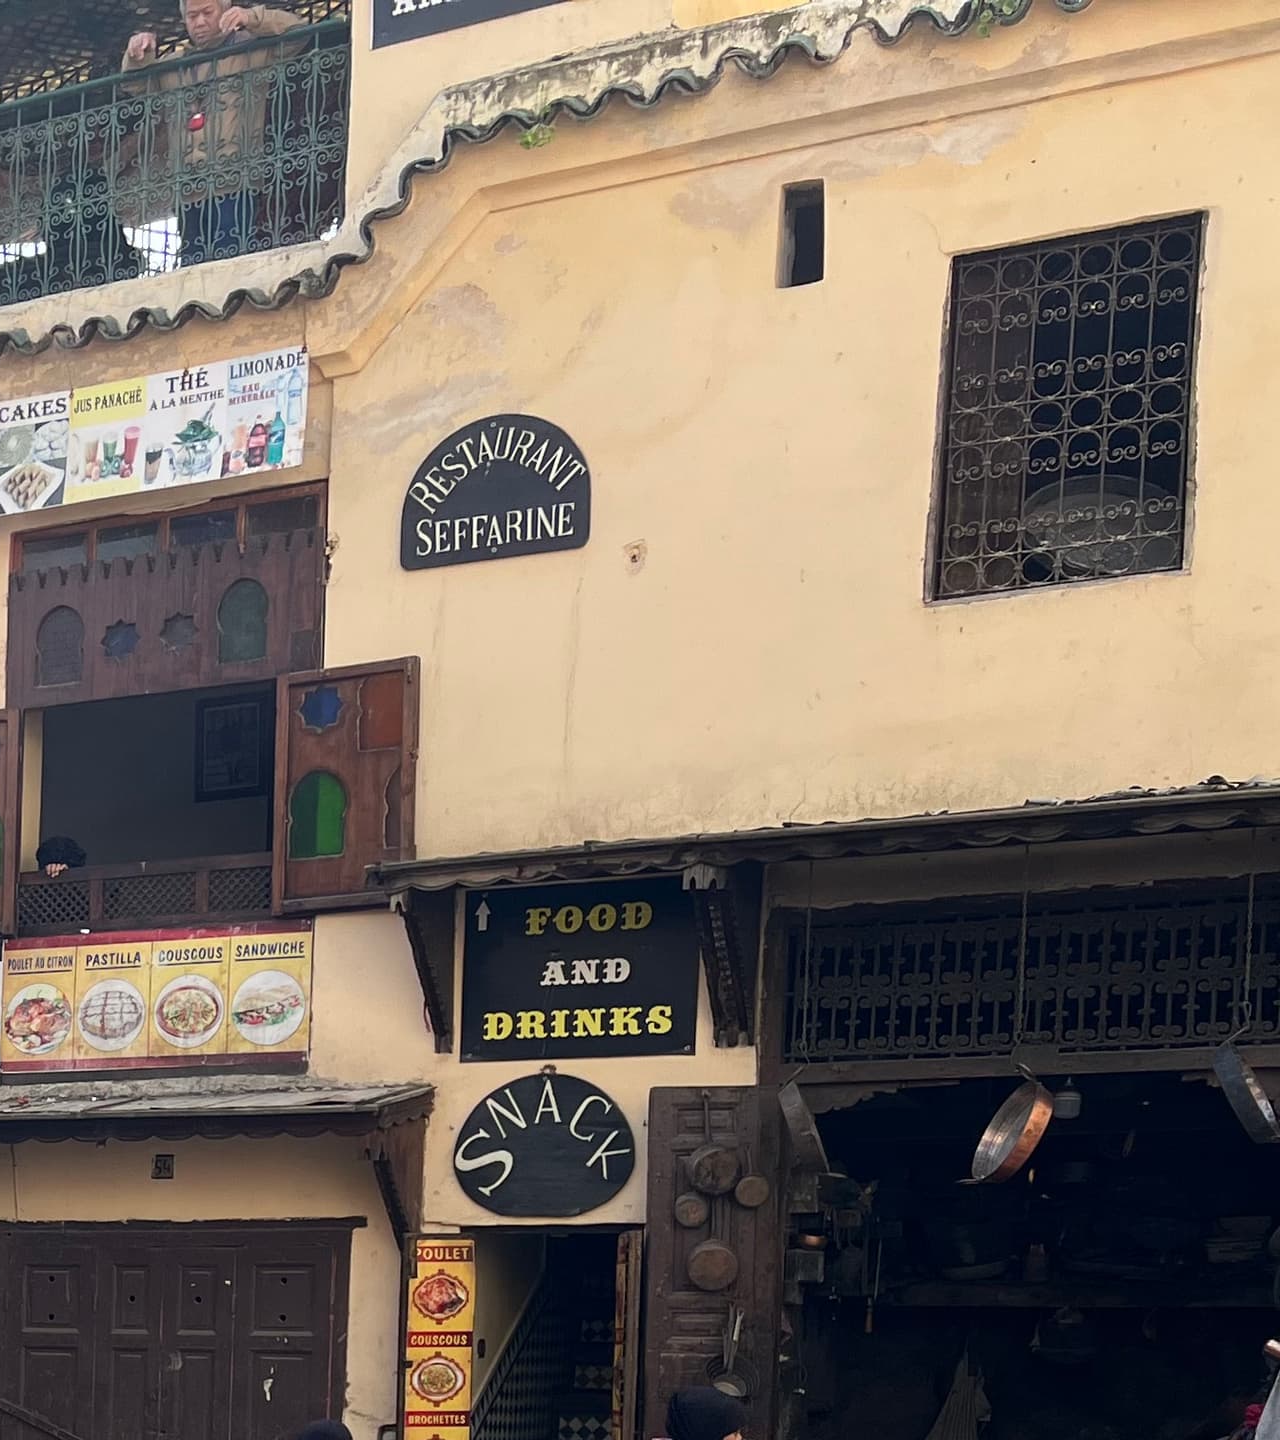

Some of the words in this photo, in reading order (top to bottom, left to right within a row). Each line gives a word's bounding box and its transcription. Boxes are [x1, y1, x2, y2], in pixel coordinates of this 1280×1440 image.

[230, 351, 306, 380] LIMONADE
[165, 368, 210, 394] THÉ
[73, 398, 92, 414] JUS
[94, 389, 143, 411] PANACHÉ
[161, 398, 176, 409] LA
[180, 389, 225, 406] MENTHE
[409, 426, 587, 515] RESTAURANT
[416, 502, 576, 557] SEFFARINE
[524, 901, 653, 935] FOOD
[85, 951, 141, 967] PASTILLA
[158, 946, 224, 963] COUSCOUS
[235, 941, 305, 958] SANDWICHE
[7, 957, 33, 971] POULET
[35, 956, 45, 969] AU
[46, 954, 73, 969] CITRON
[540, 957, 632, 987] AND
[482, 1005, 674, 1041] DRINKS
[454, 1079, 632, 1197] SNACK
[410, 1334, 468, 1346] COUSCOUS
[408, 1414, 466, 1425] BROCHETTES
